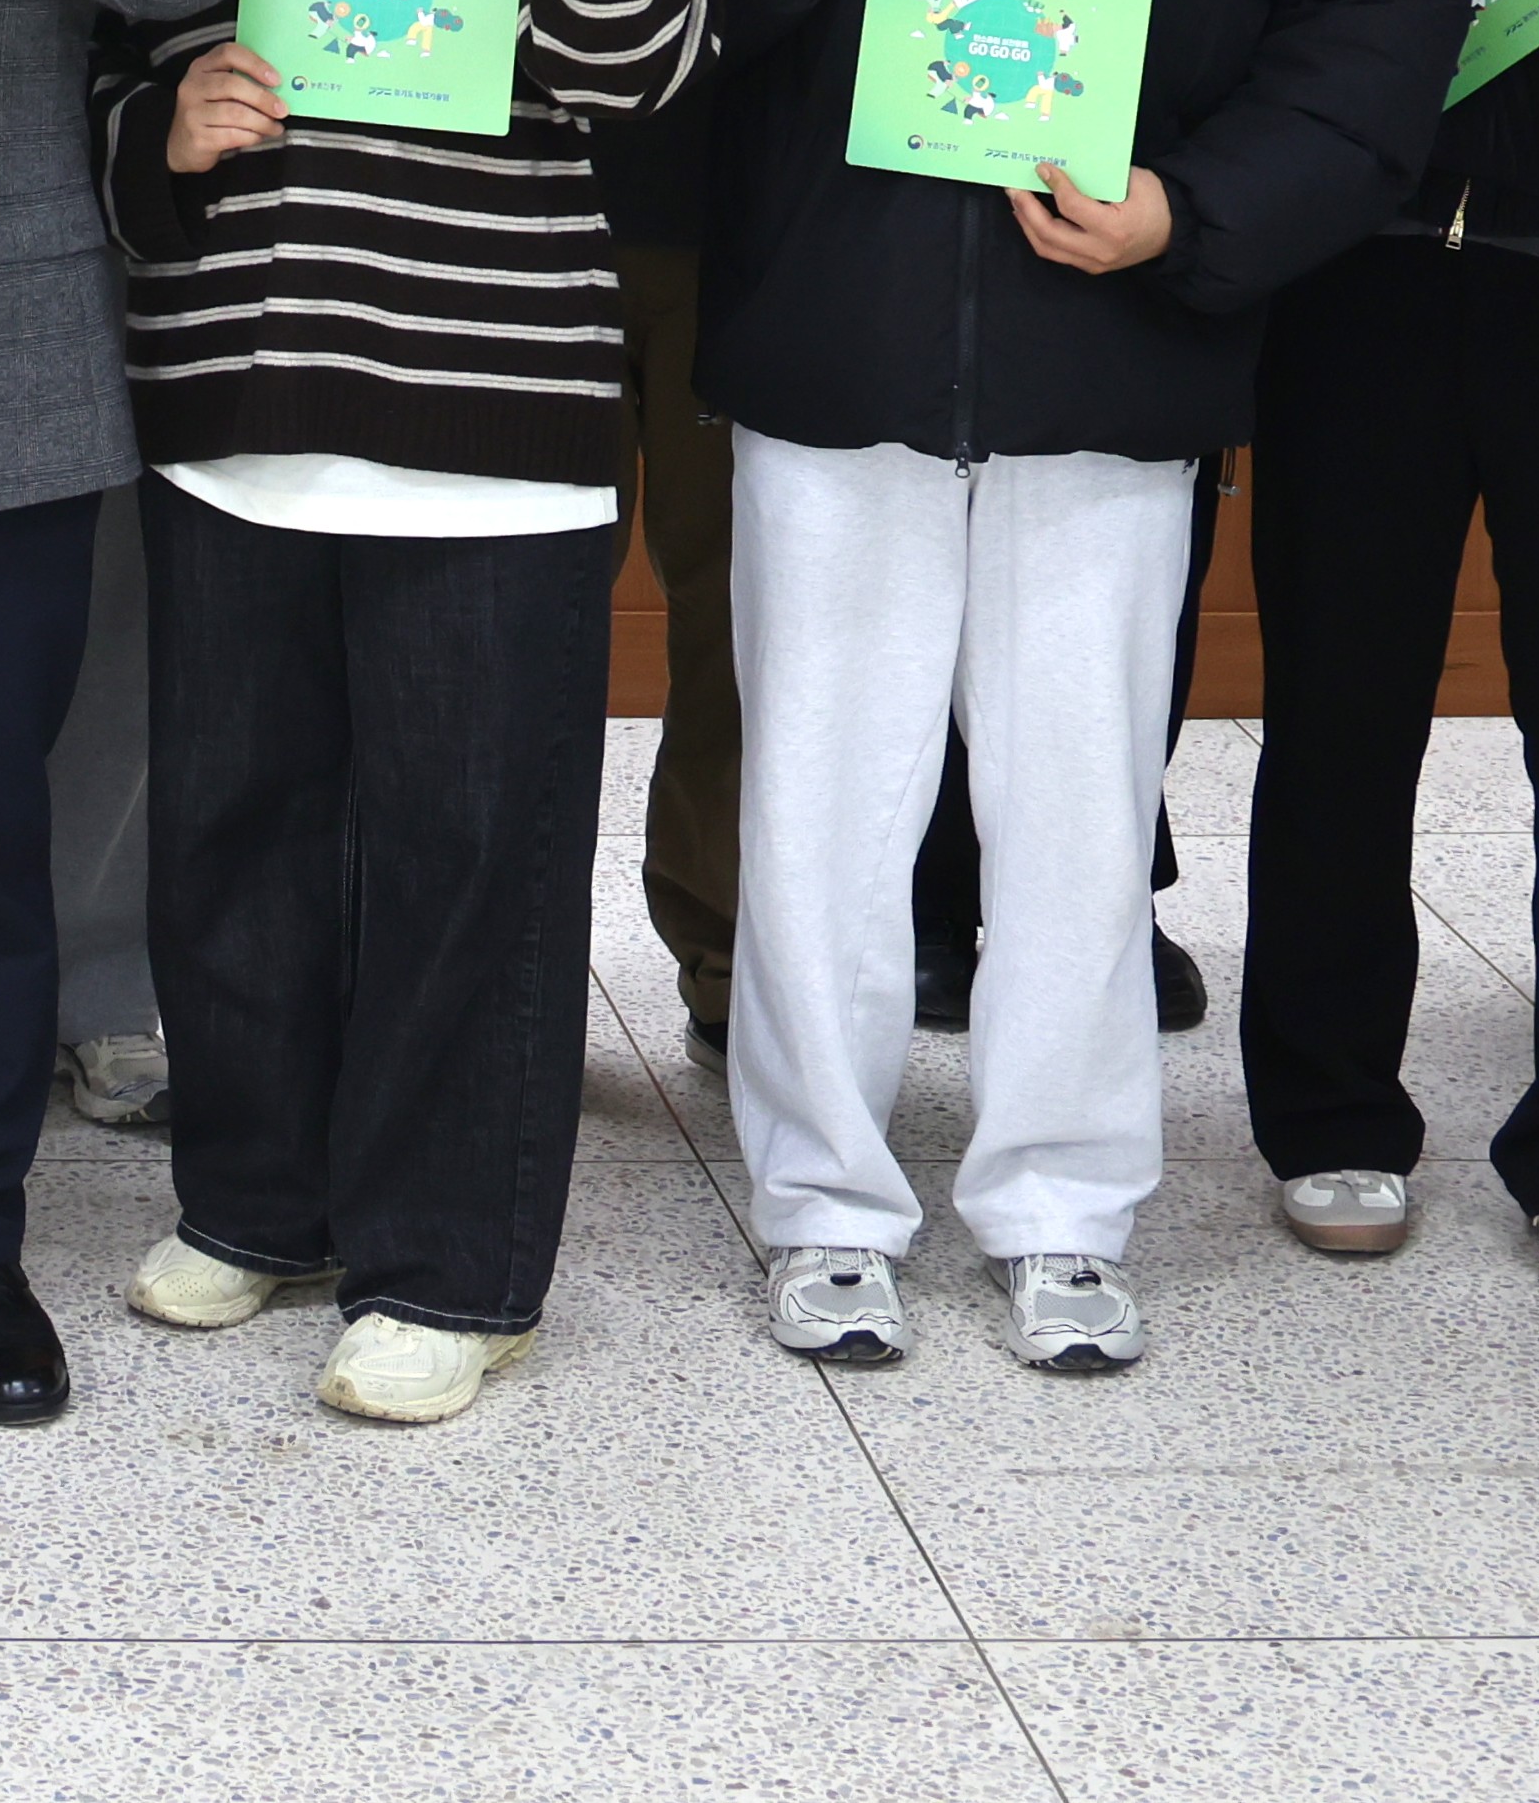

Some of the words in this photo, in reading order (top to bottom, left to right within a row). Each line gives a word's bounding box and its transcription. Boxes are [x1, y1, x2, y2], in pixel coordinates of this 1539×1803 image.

[968, 41, 988, 56] GO
[988, 44, 1010, 59] GO
[1010, 47, 1031, 61] GO
